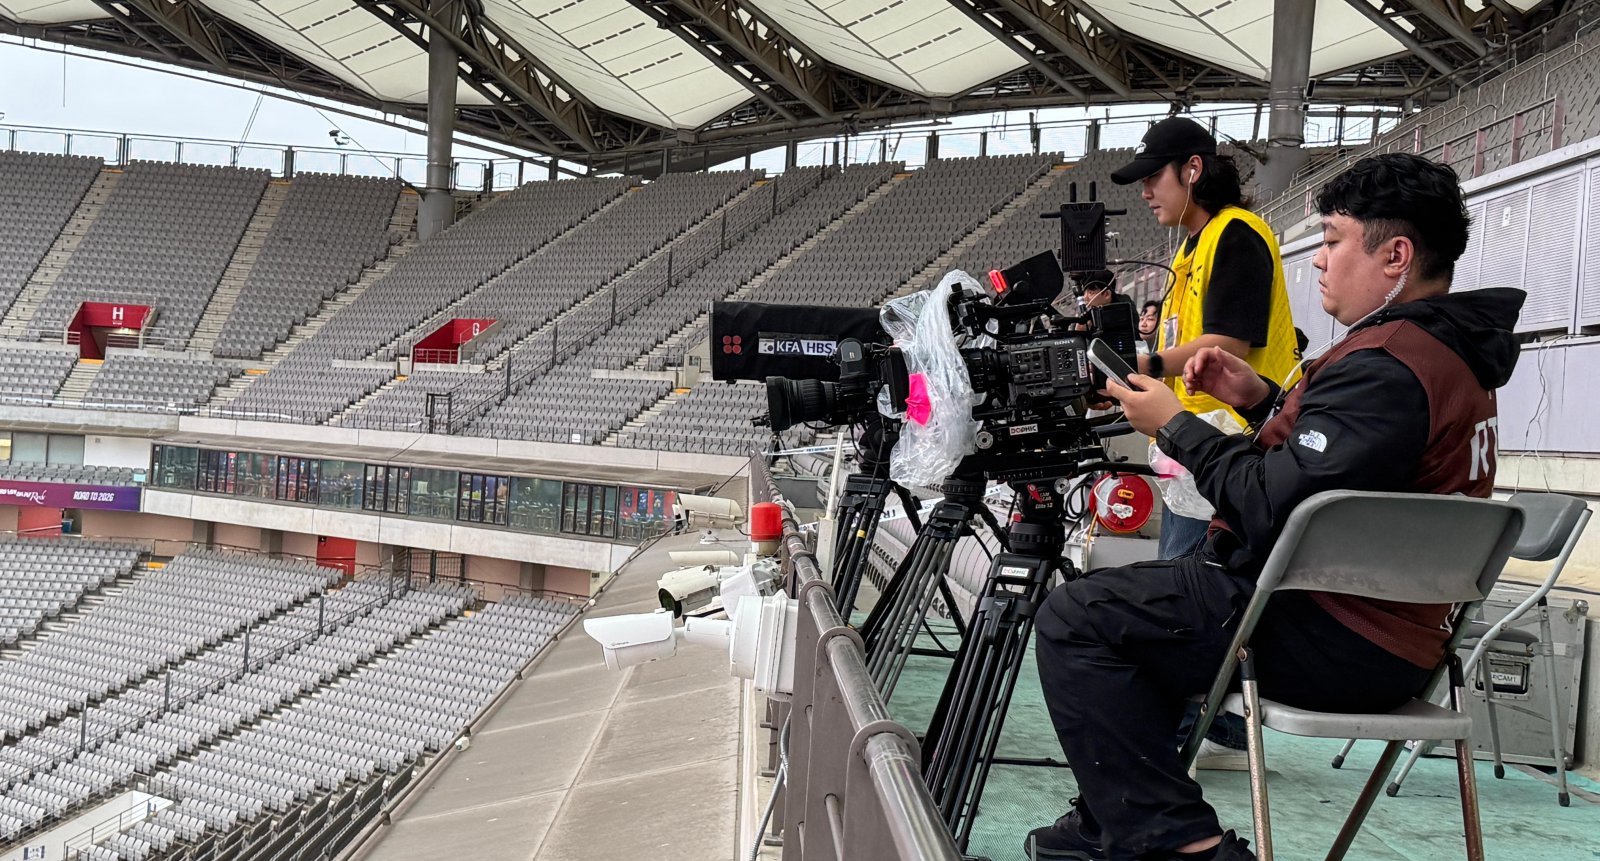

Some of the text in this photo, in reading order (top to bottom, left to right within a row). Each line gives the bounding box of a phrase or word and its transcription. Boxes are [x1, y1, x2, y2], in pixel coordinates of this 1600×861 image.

[112, 306, 124, 321] H
[472, 322, 480, 336] G
[776, 340, 833, 354] KFA HBS
[73, 491, 114, 502] ROAD TO 2026
